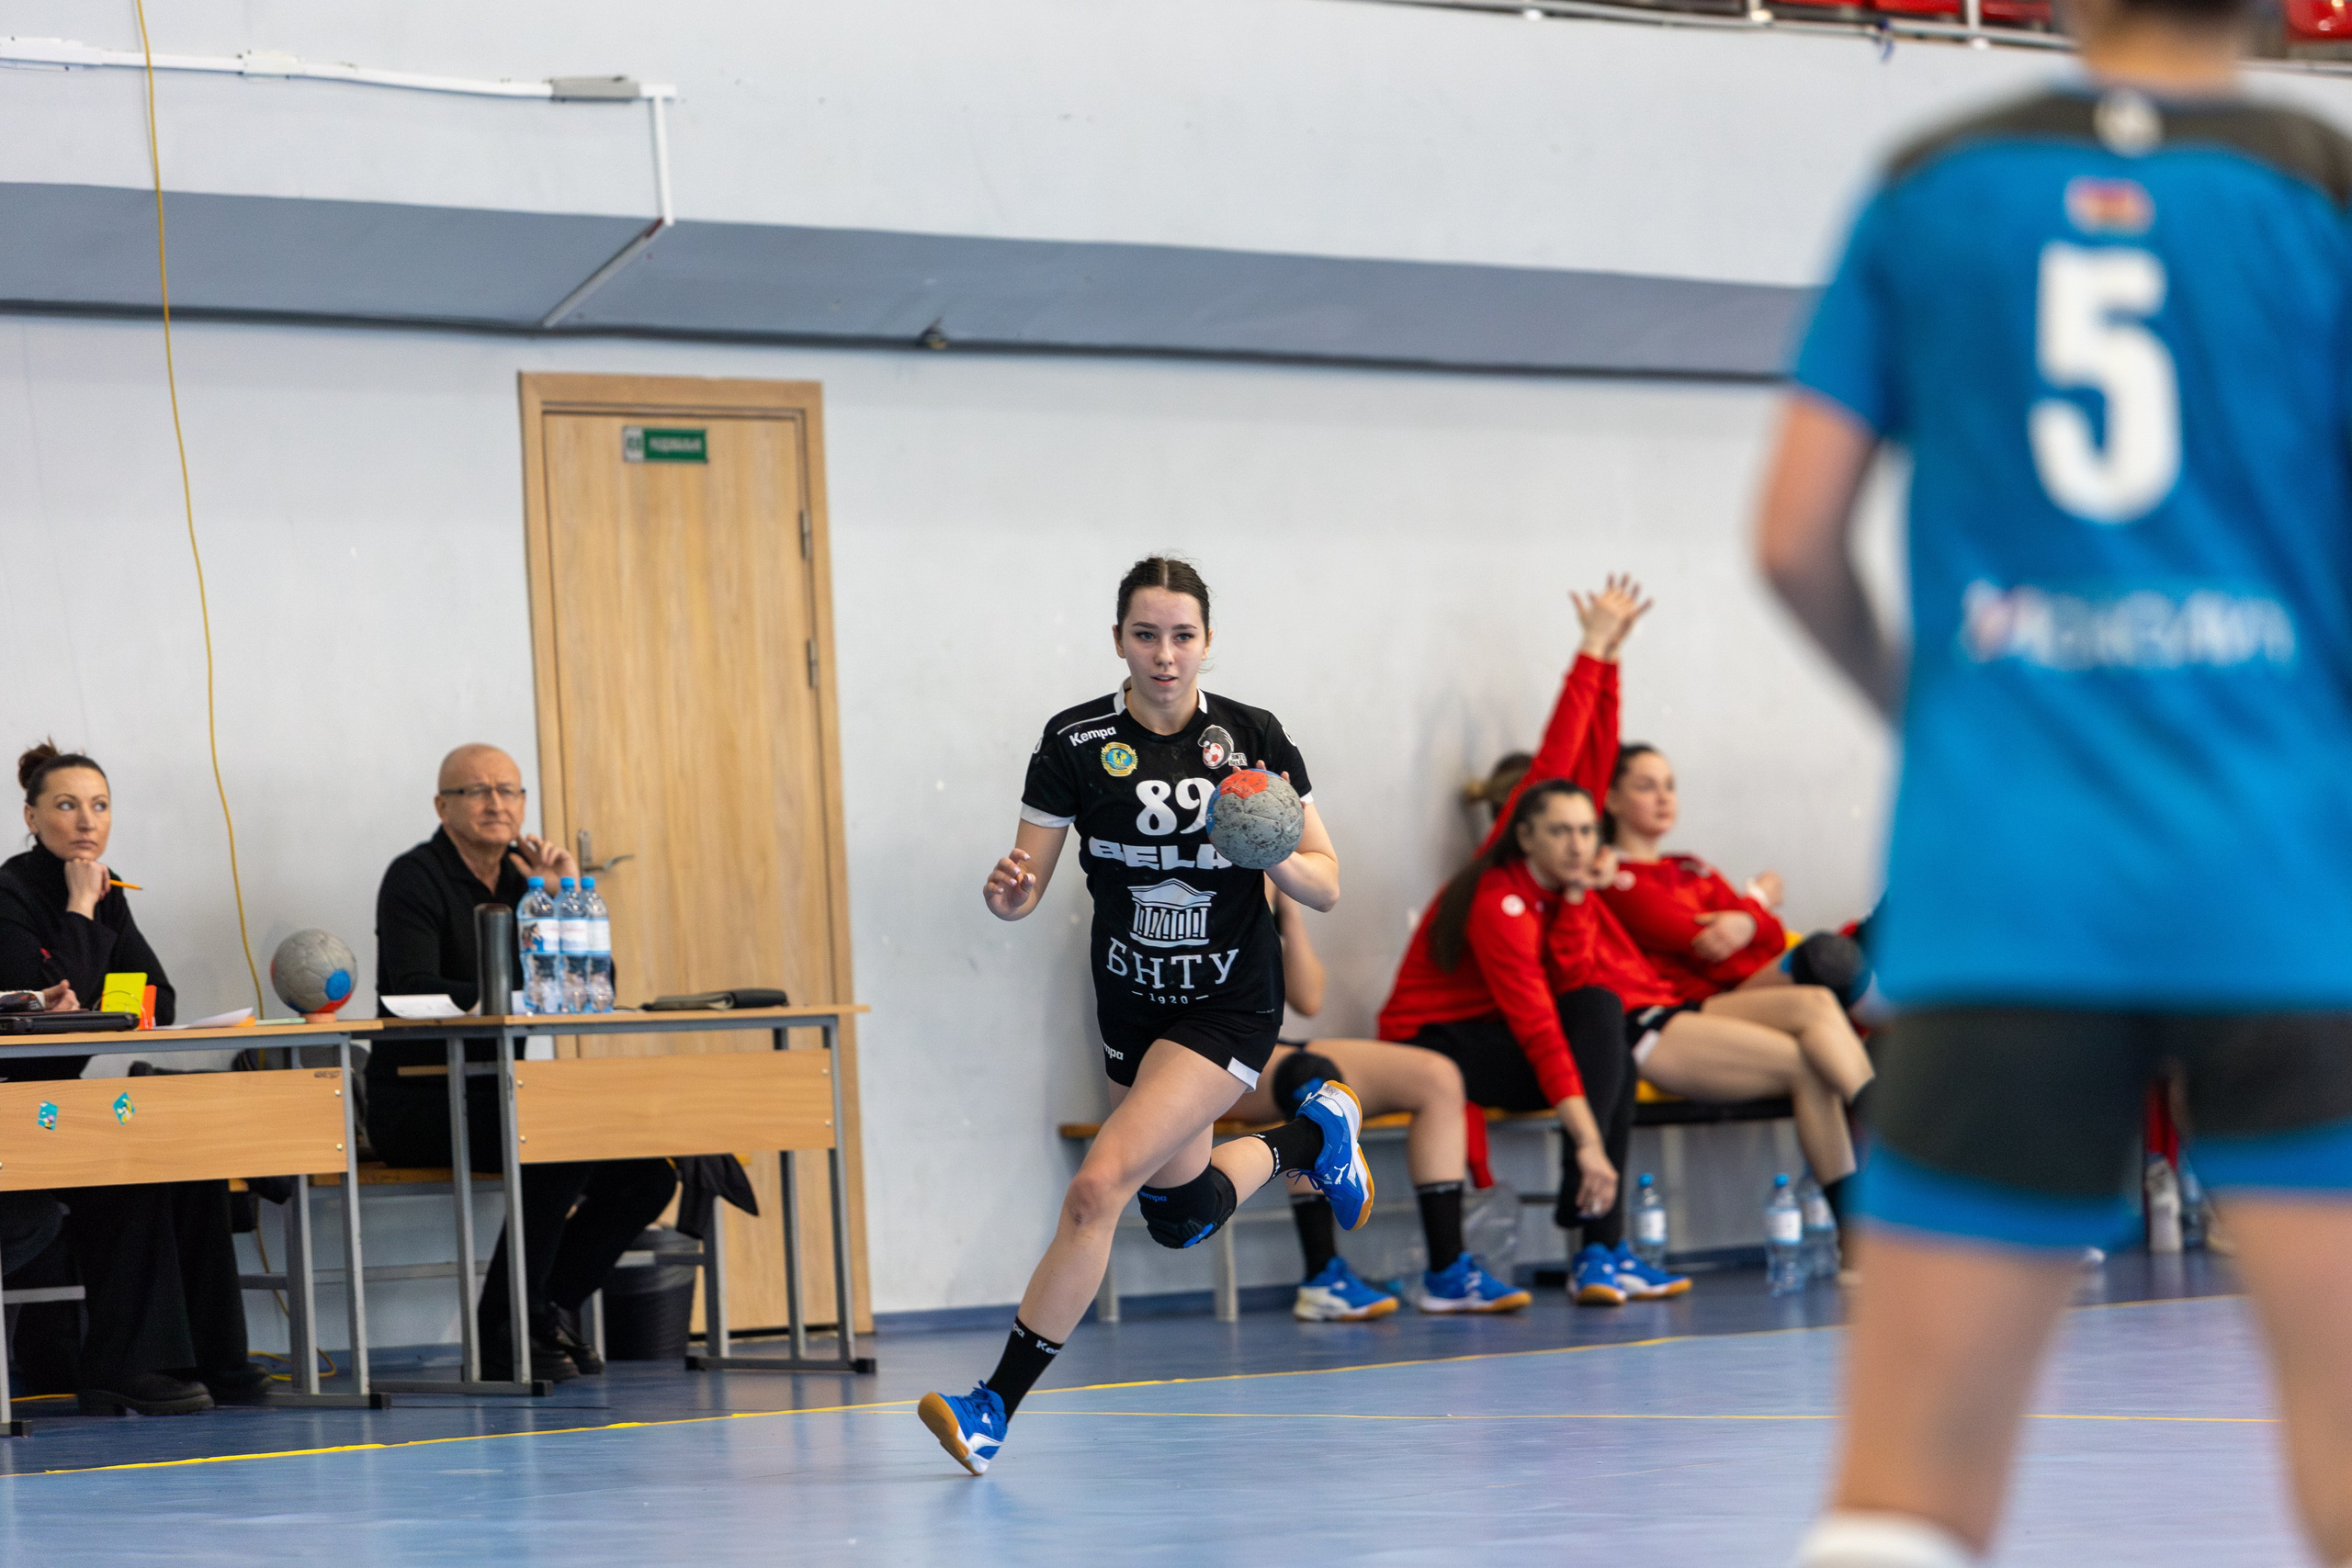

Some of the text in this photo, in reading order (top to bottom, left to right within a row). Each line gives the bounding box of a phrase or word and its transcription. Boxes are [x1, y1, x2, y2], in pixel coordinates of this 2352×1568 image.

[2029, 241, 2183, 525] 5
[1069, 727, 1117, 747] Kempa
[1136, 777, 1216, 836] 89
[1088, 836, 1233, 871] BELA
[1106, 936, 1239, 989] БНТУ
[1149, 993, 1189, 1004] 1920
[1103, 1043, 1124, 1061] mpa
